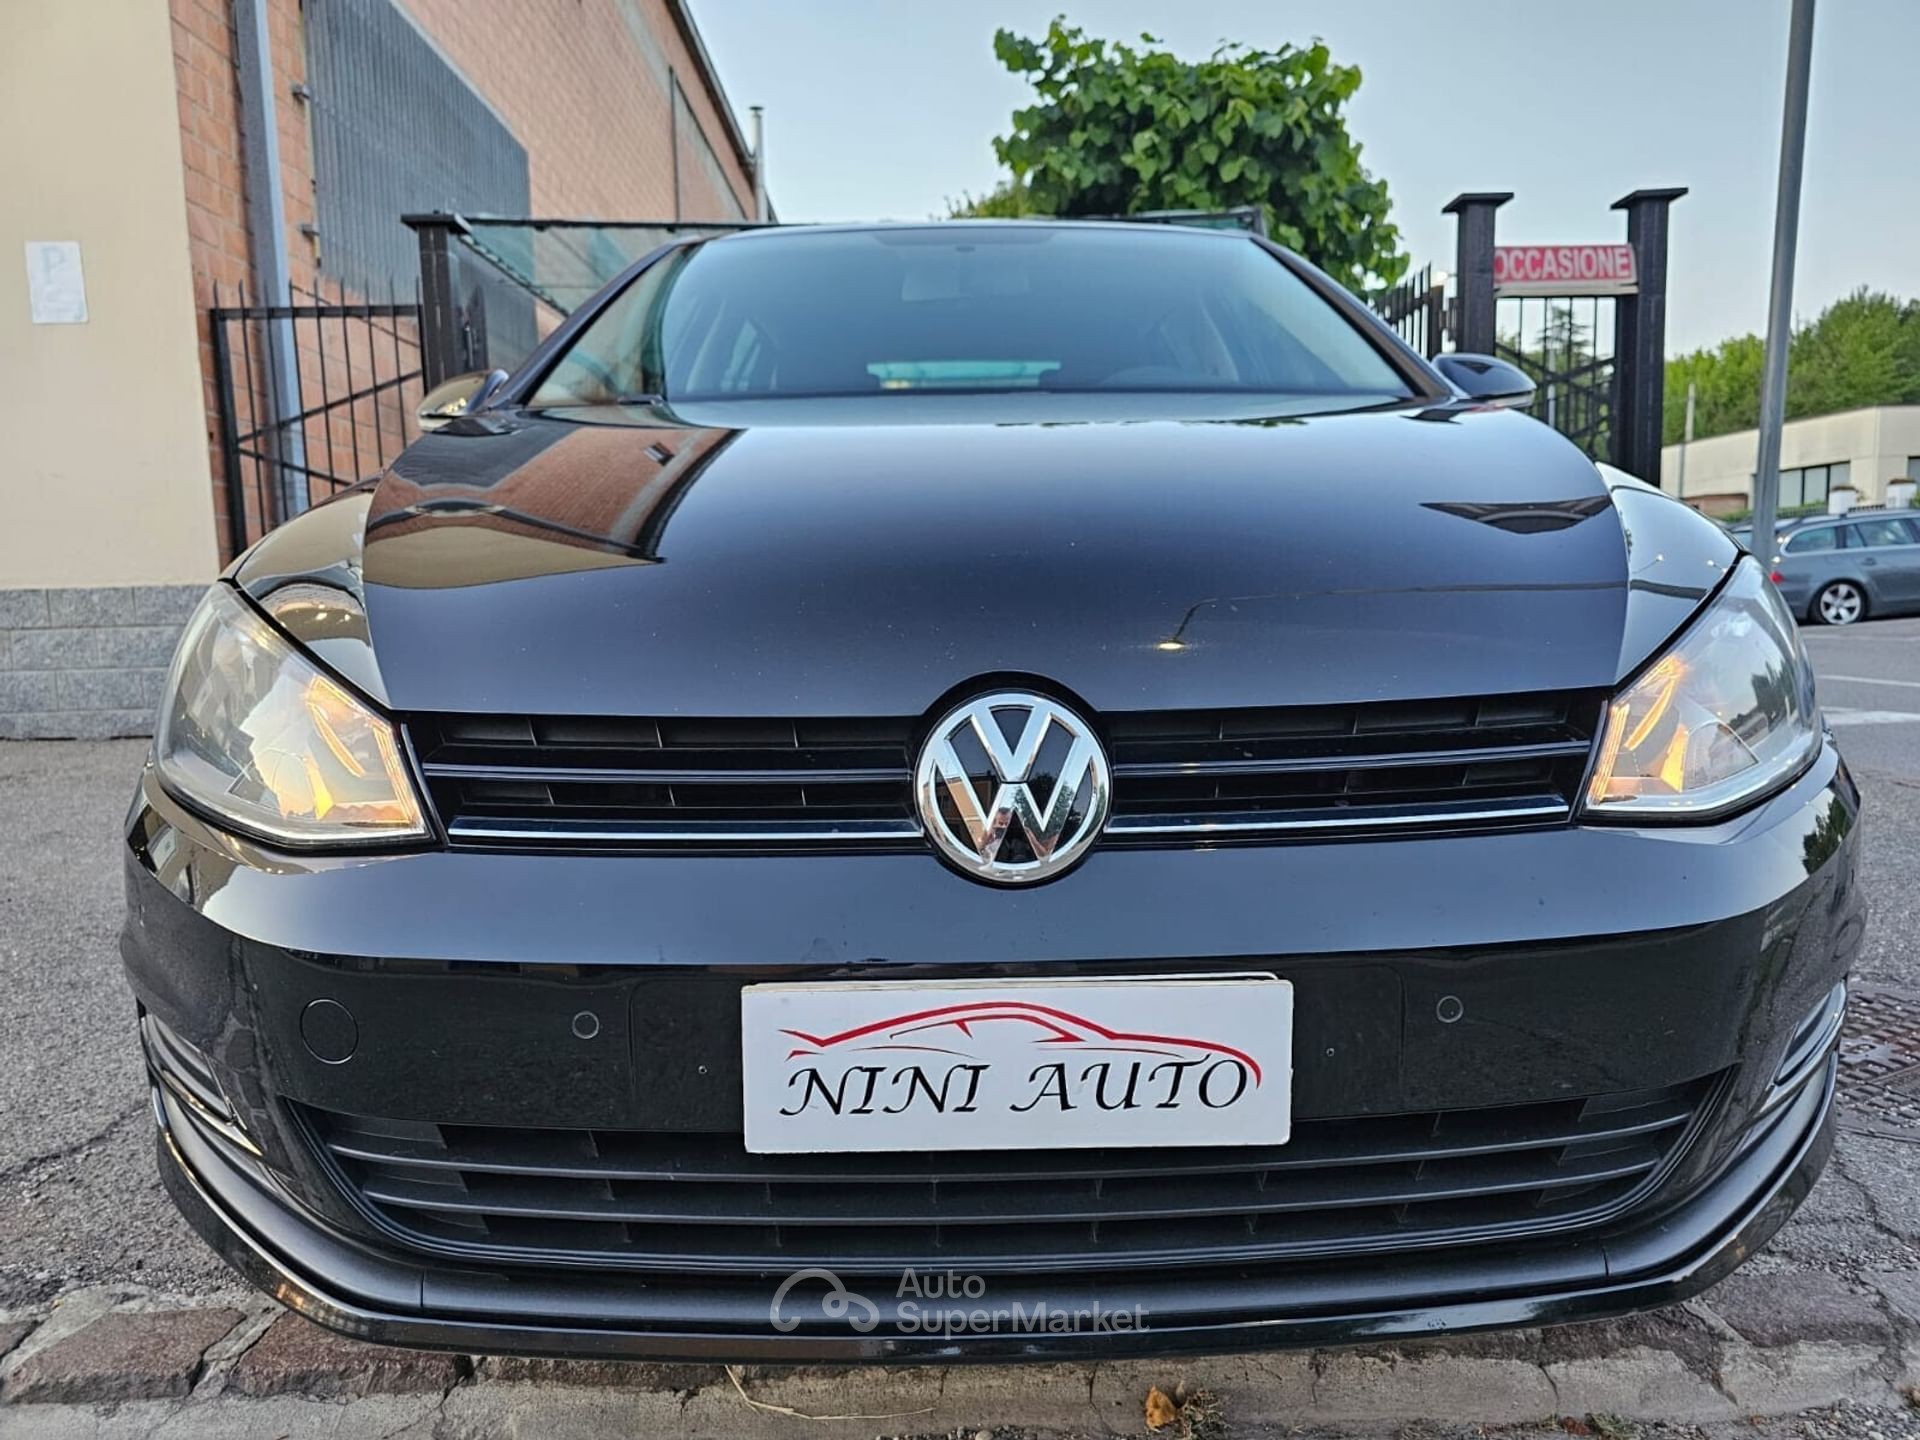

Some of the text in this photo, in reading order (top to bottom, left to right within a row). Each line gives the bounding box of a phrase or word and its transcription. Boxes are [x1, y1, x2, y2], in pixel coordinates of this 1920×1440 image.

[1494, 247, 1629, 280] OCCASIONE
[780, 1053, 1248, 1116] NINI AUTO
